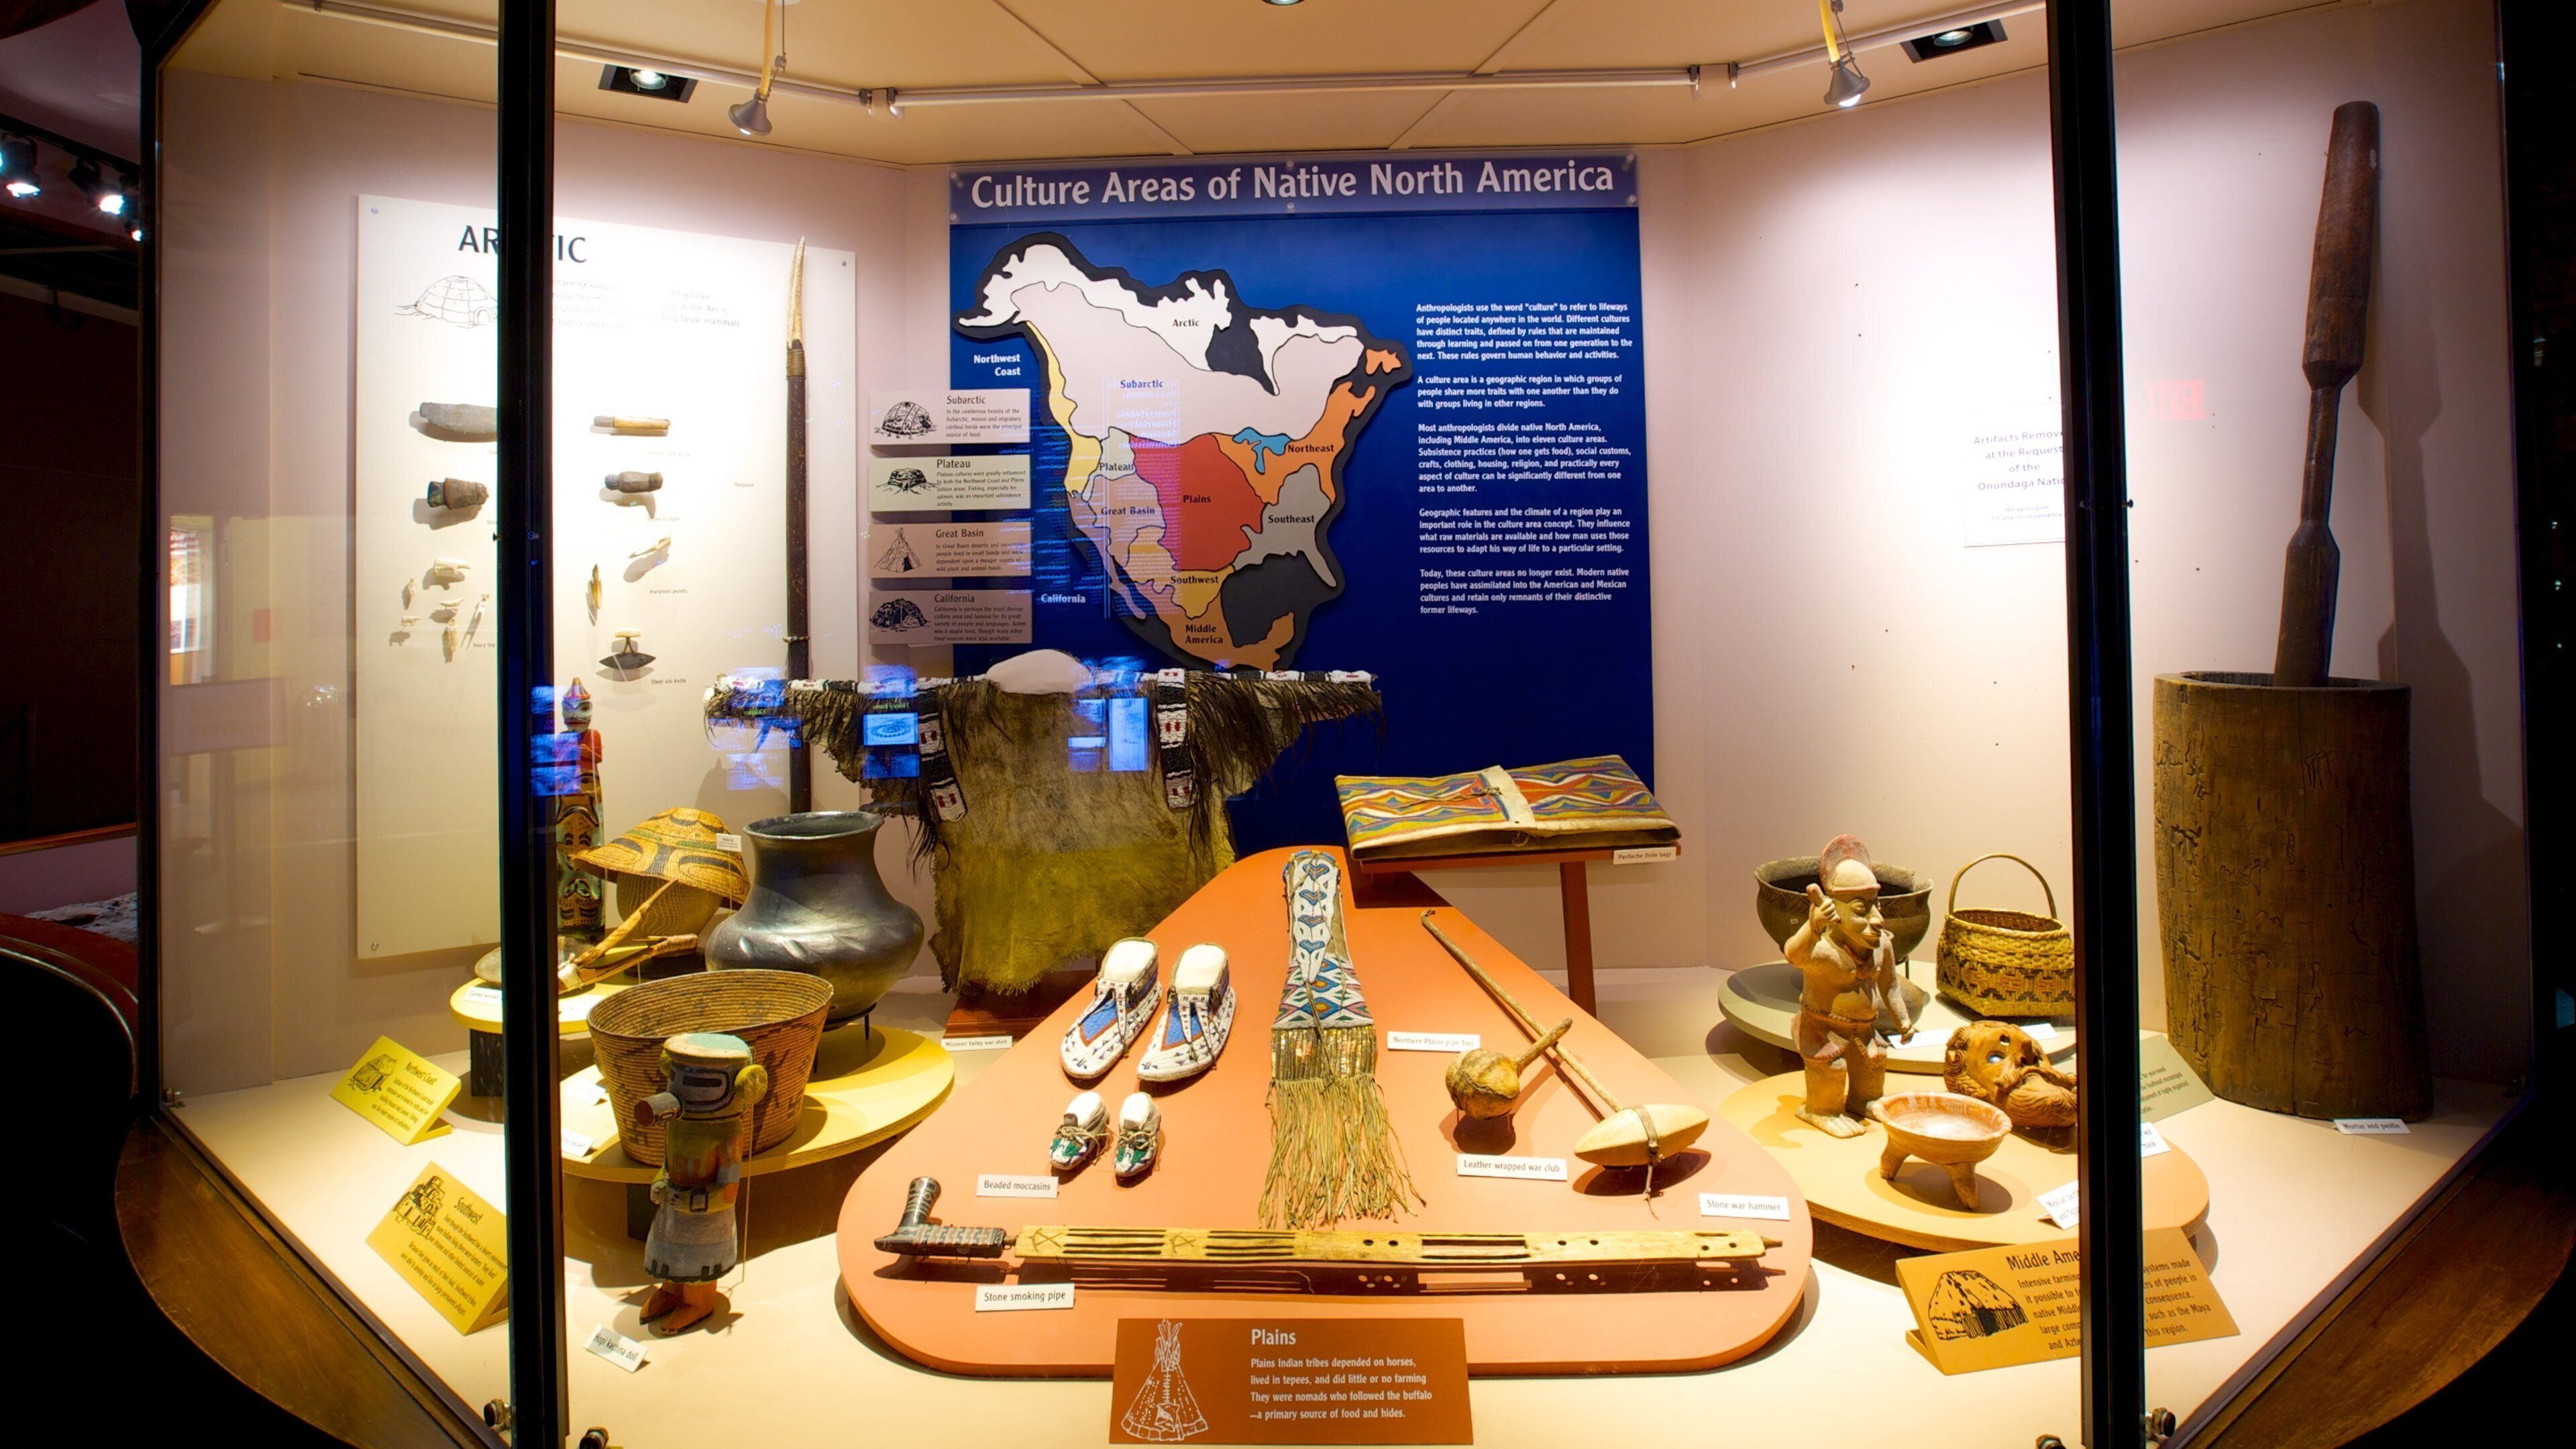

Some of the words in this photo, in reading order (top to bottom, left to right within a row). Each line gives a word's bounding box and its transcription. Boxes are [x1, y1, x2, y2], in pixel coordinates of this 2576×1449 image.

[971, 175, 1089, 208] Culture
[1101, 171, 1195, 203] Areas
[1208, 168, 1240, 200] of
[1254, 165, 1356, 198] Native
[1371, 162, 1463, 195] North
[1476, 160, 1613, 193] America
[458, 225, 587, 264] ARIC
[1415, 303, 1474, 313] Anthropologists
[1490, 303, 1503, 311] the
[1503, 303, 1523, 311] word
[1524, 303, 1558, 311] "culture"
[1559, 303, 1568, 311] to
[1569, 303, 1587, 311] refer
[1589, 303, 1597, 311] to
[1599, 303, 1627, 312] lifeways
[1173, 319, 1198, 327] Arctic
[1415, 315, 1424, 324] of
[1426, 315, 1451, 325] people
[1452, 315, 1479, 323] located
[1481, 315, 1516, 325] anywhere
[1517, 315, 1525, 323] in
[1526, 315, 1540, 323] the
[1540, 315, 1564, 323] world.
[1566, 314, 1599, 323] Different
[1600, 314, 1630, 323] cultures
[1416, 327, 1434, 335] have
[1435, 327, 1462, 335] distinct
[1464, 327, 1486, 336] traits,
[1487, 327, 1515, 335] defined
[1517, 327, 1526, 337] by
[1527, 327, 1546, 335] rules
[1548, 326, 1563, 335] that
[1578, 326, 1619, 335] maintained
[973, 354, 1020, 364] Northwest
[994, 366, 1020, 376] Coast
[1120, 379, 1163, 388] Subarctic
[947, 394, 985, 404] Subarctic
[1287, 443, 1334, 453] Northeast
[936, 459, 971, 468] Plateau
[1099, 462, 1134, 472] Plateau
[1183, 494, 1212, 503] Plains
[1100, 506, 1126, 515] Great
[1130, 506, 1155, 515] Basin
[1268, 515, 1315, 524] Southeast
[935, 529, 958, 538] Great
[961, 529, 983, 537] Basin
[1171, 576, 1219, 584] Southwest
[934, 593, 975, 603] California
[1040, 593, 1085, 603] California
[1185, 624, 1217, 633] Middle
[1185, 635, 1223, 644] America
[1393, 1036, 1421, 1044] Northern
[1464, 1159, 1491, 1168] Leather
[1494, 1163, 1525, 1171] wrapped
[1544, 1164, 1560, 1172] club
[983, 1179, 1011, 1189] Beaded
[1013, 1181, 1051, 1191] moccasins
[1707, 1199, 1729, 1208] Stone
[1748, 1201, 1780, 1210] hammer
[453, 1196, 483, 1225] Southwest
[2005, 1252, 2050, 1271] Middle
[2170, 1258, 2191, 1269] made
[2017, 1277, 2051, 1289] Intensive
[2153, 1277, 2162, 1287] of
[2164, 1274, 2188, 1287] people
[2188, 1273, 2198, 1282] in
[984, 1292, 1008, 1301] Stone
[1010, 1291, 1045, 1301] smoking
[1047, 1292, 1065, 1301] pipe
[2025, 1295, 2033, 1303] it
[2033, 1290, 2063, 1304] possible
[2145, 1291, 2194, 1305] consequence,
[2033, 1309, 2058, 1319] native
[2148, 1309, 2166, 1320] such
[2167, 1309, 2176, 1318] as
[2176, 1306, 2190, 1316] the
[2189, 1303, 2211, 1313] Maya
[2039, 1325, 2060, 1335] large
[2145, 1327, 2161, 1338] this
[2162, 1324, 2188, 1336] region.
[1251, 1328, 1296, 1345] Plains
[593, 1333, 607, 1347] Hopi
[606, 1338, 626, 1356] kachina
[626, 1350, 639, 1361] doll
[2047, 1339, 2063, 1350] and
[1250, 1358, 1275, 1368] Plains
[1277, 1358, 1303, 1368] Indian
[1305, 1357, 1329, 1367] tribes
[1331, 1356, 1371, 1369] depended
[1373, 1358, 1384, 1366] on
[1386, 1356, 1416, 1367] horses,
[1250, 1375, 1270, 1385] lived
[1272, 1375, 1280, 1385] in
[1282, 1375, 1311, 1386] tepees,
[1314, 1374, 1330, 1384] and
[1332, 1373, 1346, 1384] did
[1348, 1373, 1367, 1383] little
[1369, 1375, 1379, 1383] or
[1381, 1375, 1392, 1383] no
[1394, 1373, 1426, 1385] farming
[1250, 1391, 1270, 1403] They
[1272, 1393, 1293, 1401] were
[1295, 1391, 1328, 1401] nomads
[1329, 1391, 1347, 1401] who
[1349, 1390, 1385, 1401] followed
[1386, 1390, 1401, 1400] the
[1402, 1389, 1432, 1400] buffalo
[1249, 1411, 1262, 1419] —a
[1265, 1409, 1297, 1421] primary
[1299, 1410, 1327, 1419] source
[1329, 1408, 1338, 1418] of
[1340, 1407, 1360, 1418] food
[1362, 1407, 1378, 1418] and
[1381, 1407, 1405, 1417] hides.
